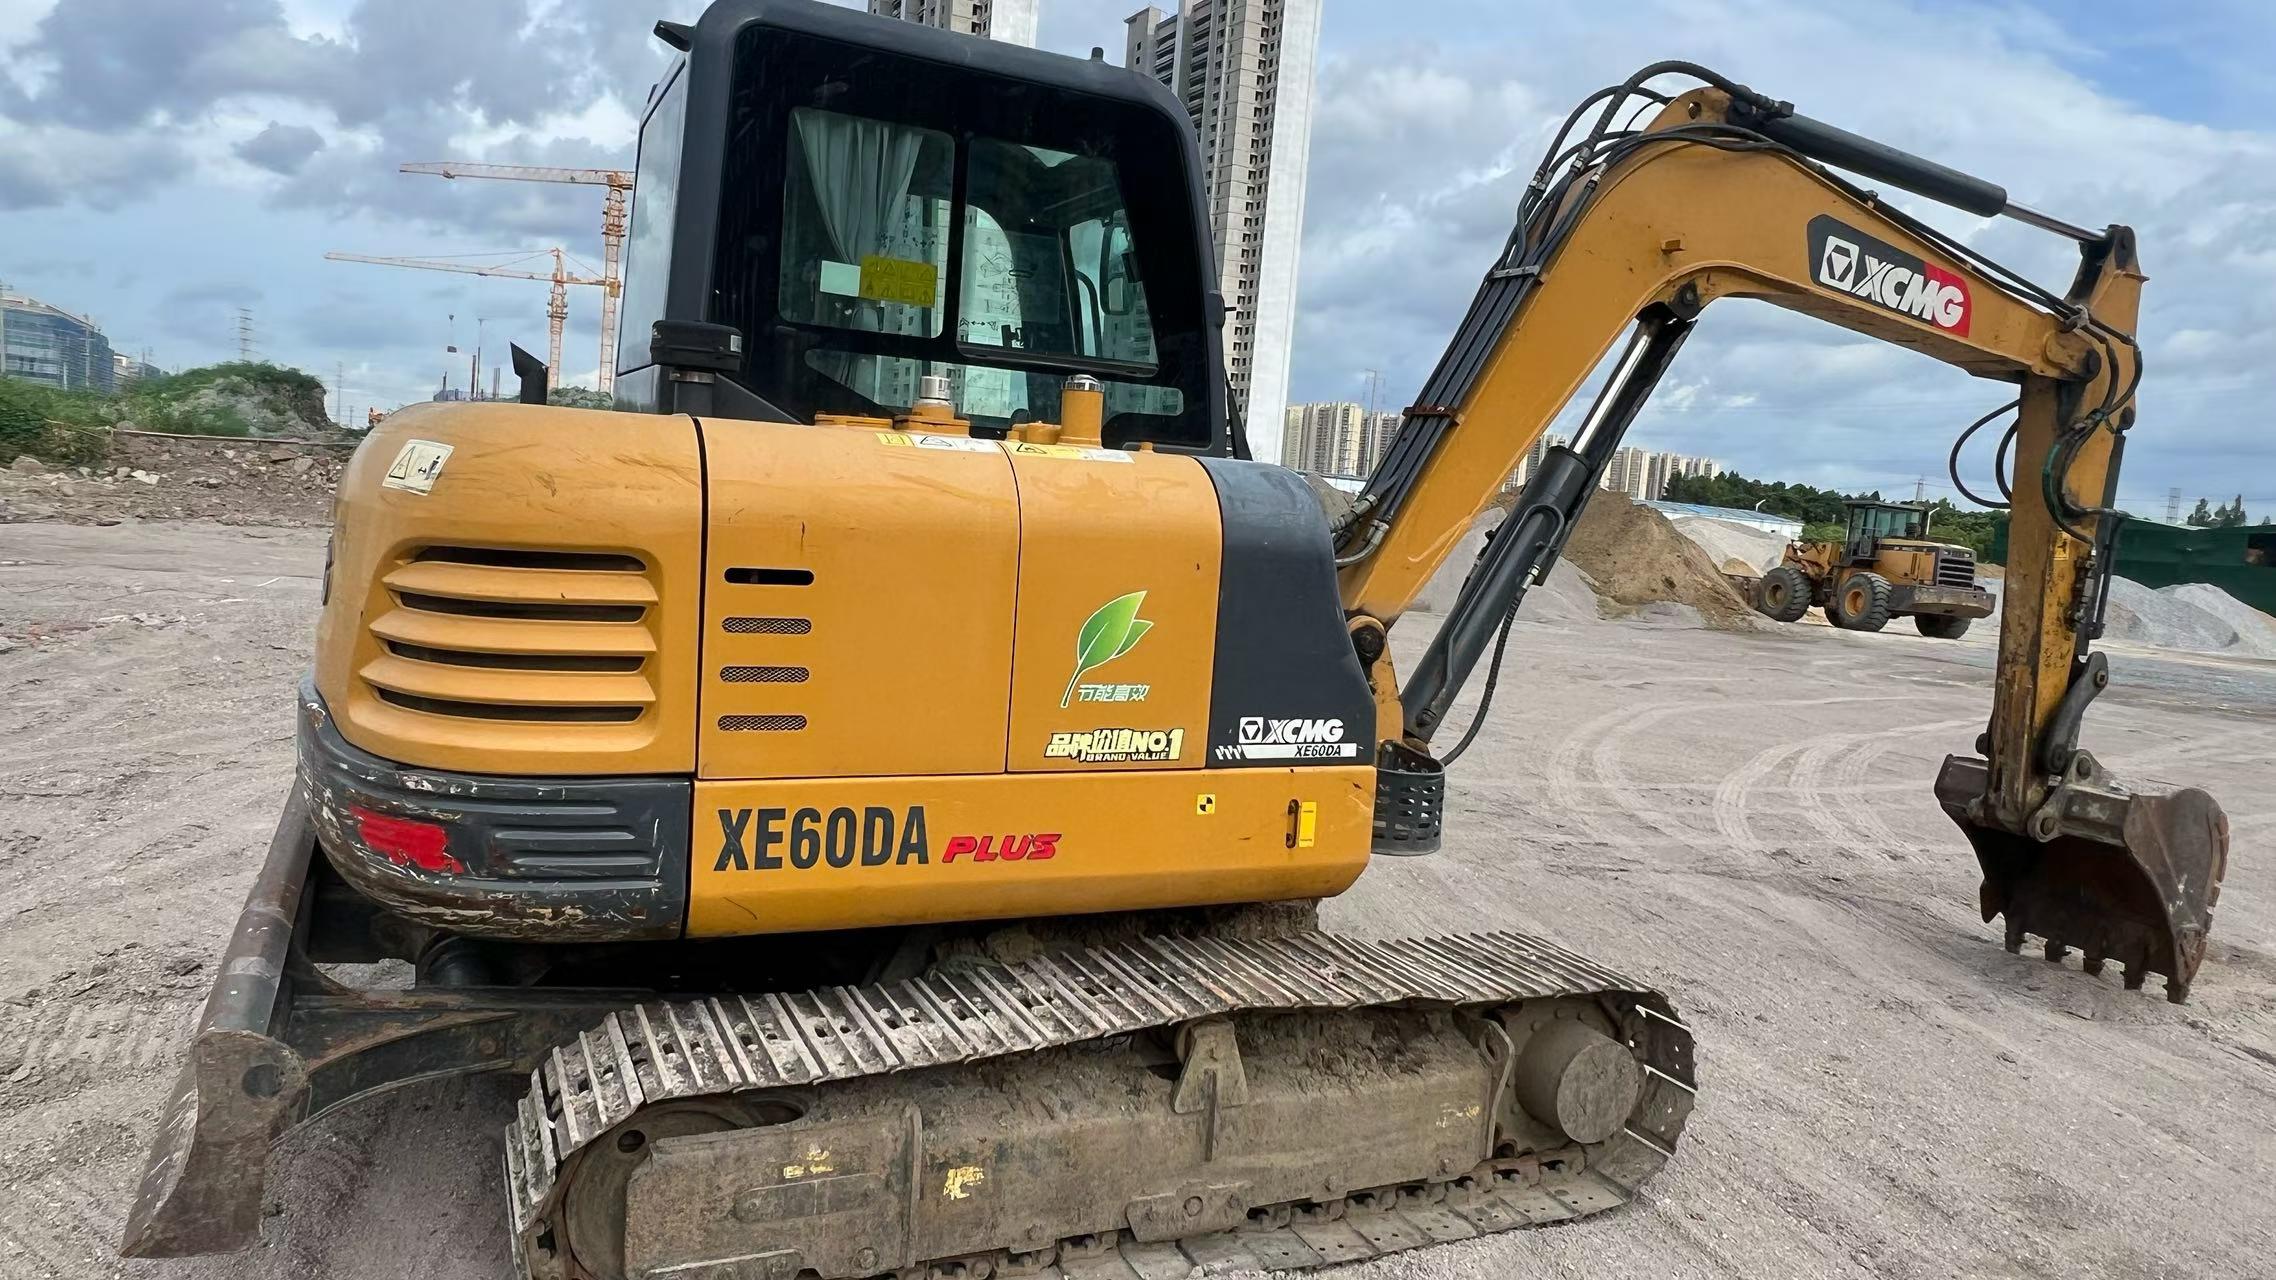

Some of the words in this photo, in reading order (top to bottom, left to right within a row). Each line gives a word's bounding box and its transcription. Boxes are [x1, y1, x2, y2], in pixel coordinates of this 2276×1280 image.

[1850, 254, 1965, 329] XCMG
[1077, 684, 1151, 702] 节能高效
[1261, 718, 1345, 744] XCMG
[1084, 752, 1127, 762] BRAND
[1131, 751, 1168, 761] VALUE
[1294, 744, 1342, 758] XE60DA
[713, 805, 929, 871] XE60DA
[942, 833, 1063, 864] PLUS
